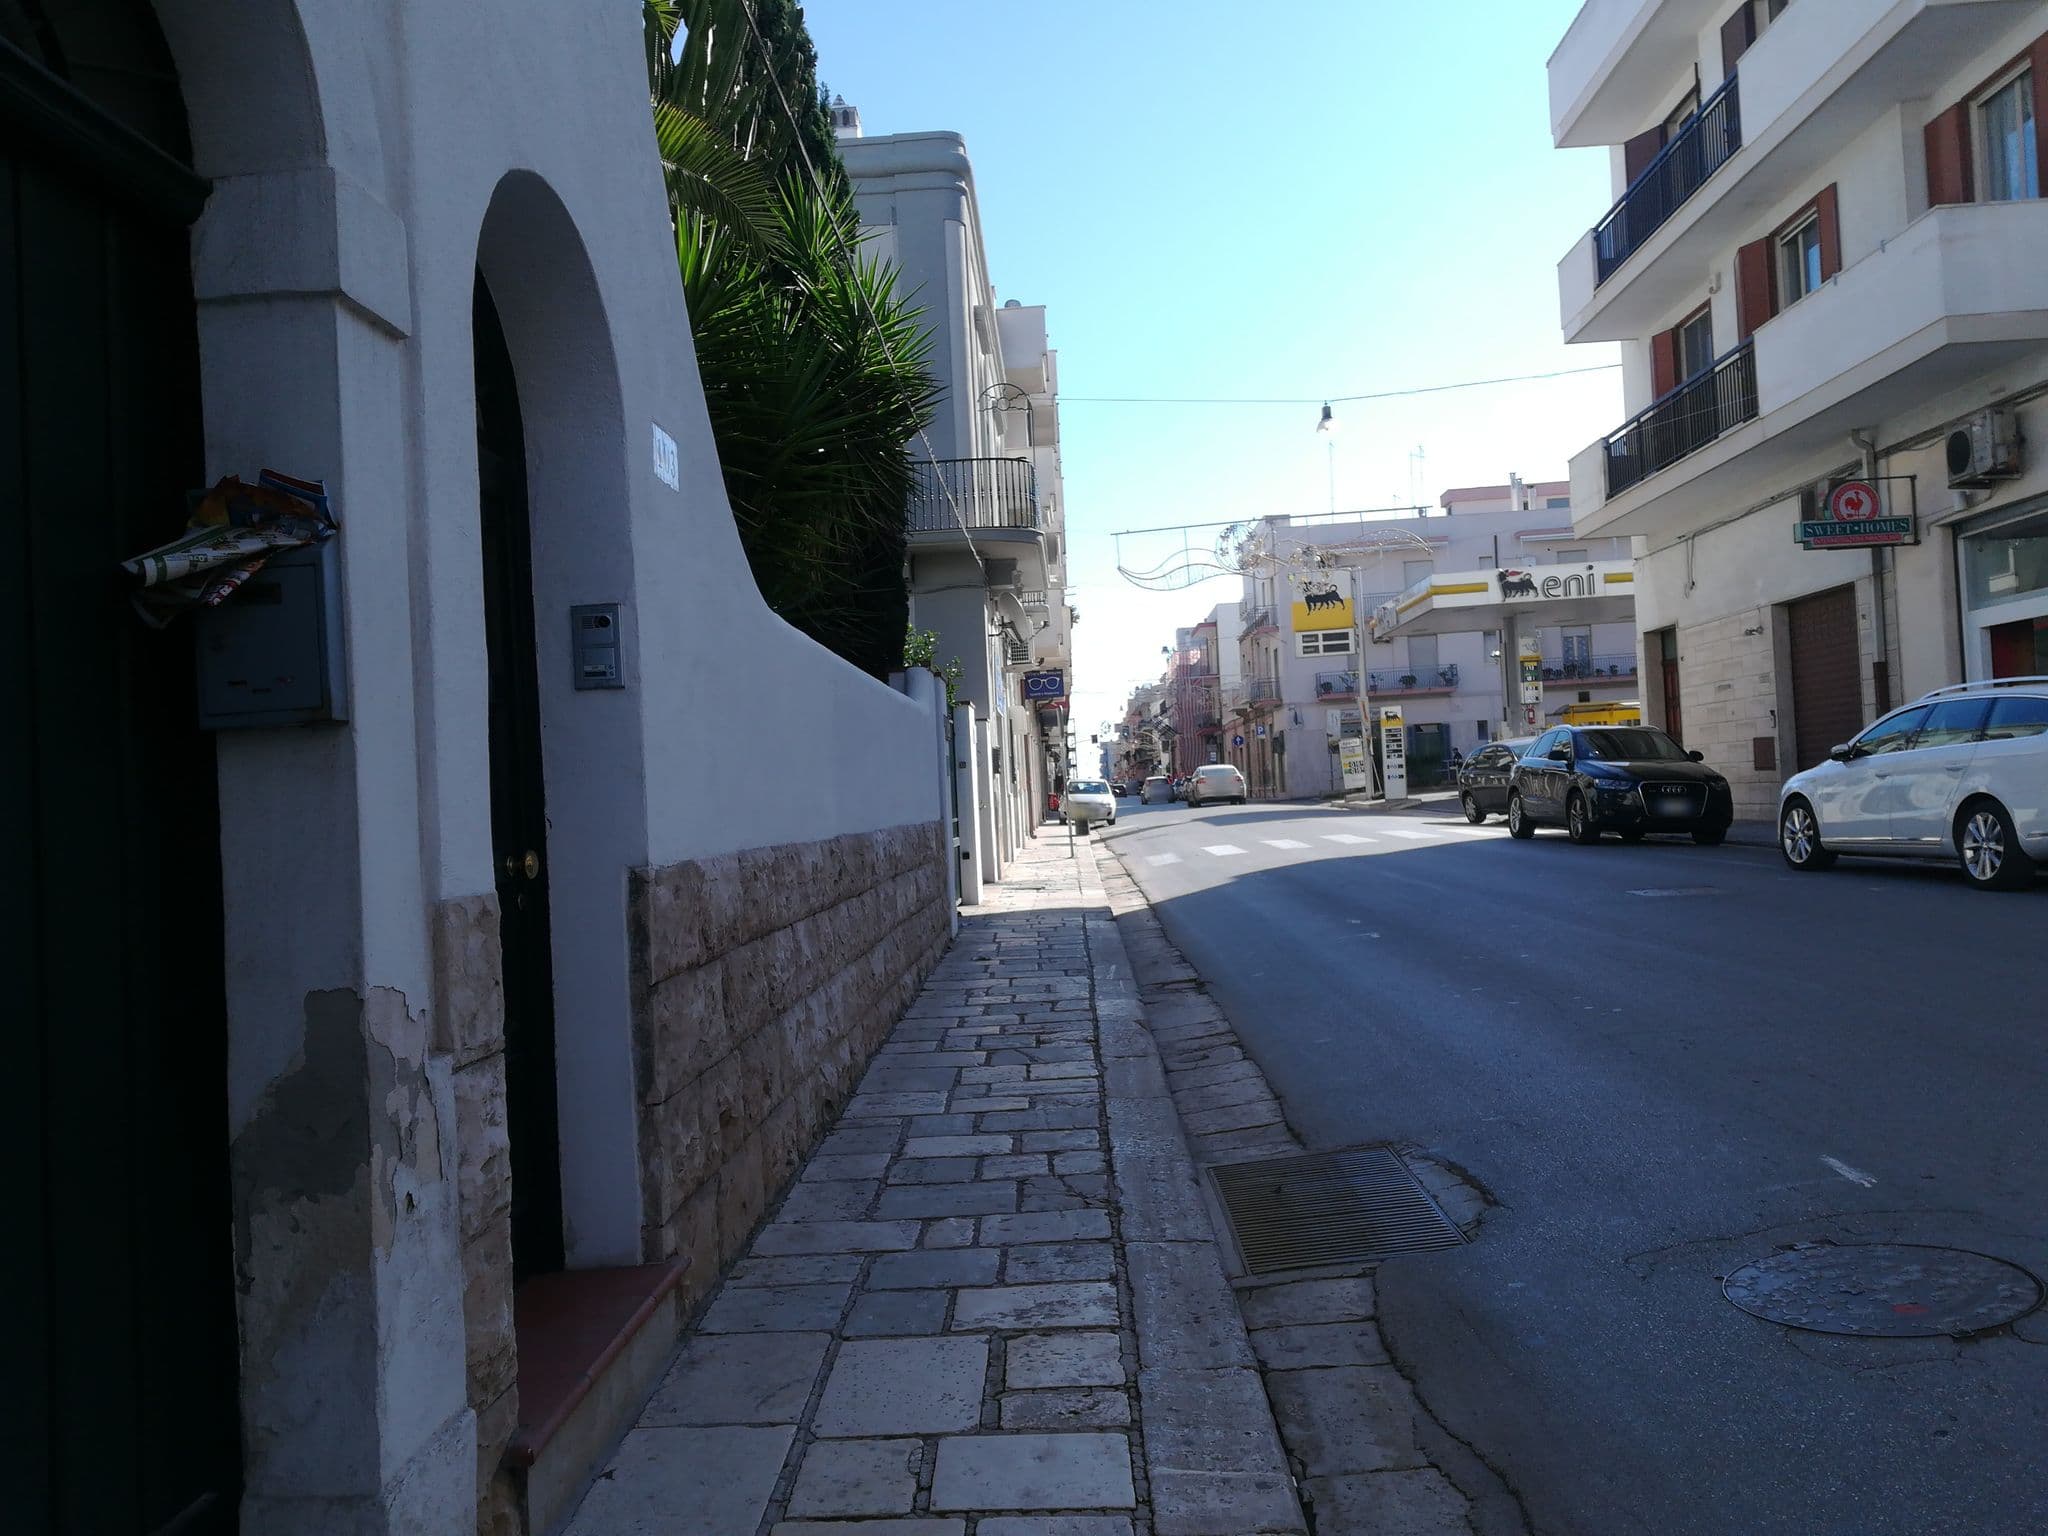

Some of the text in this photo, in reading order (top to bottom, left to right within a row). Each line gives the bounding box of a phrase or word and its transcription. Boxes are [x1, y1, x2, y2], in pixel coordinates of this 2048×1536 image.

[1805, 518, 1908, 537] SWEET HOMES
[1543, 565, 1596, 599] eni
